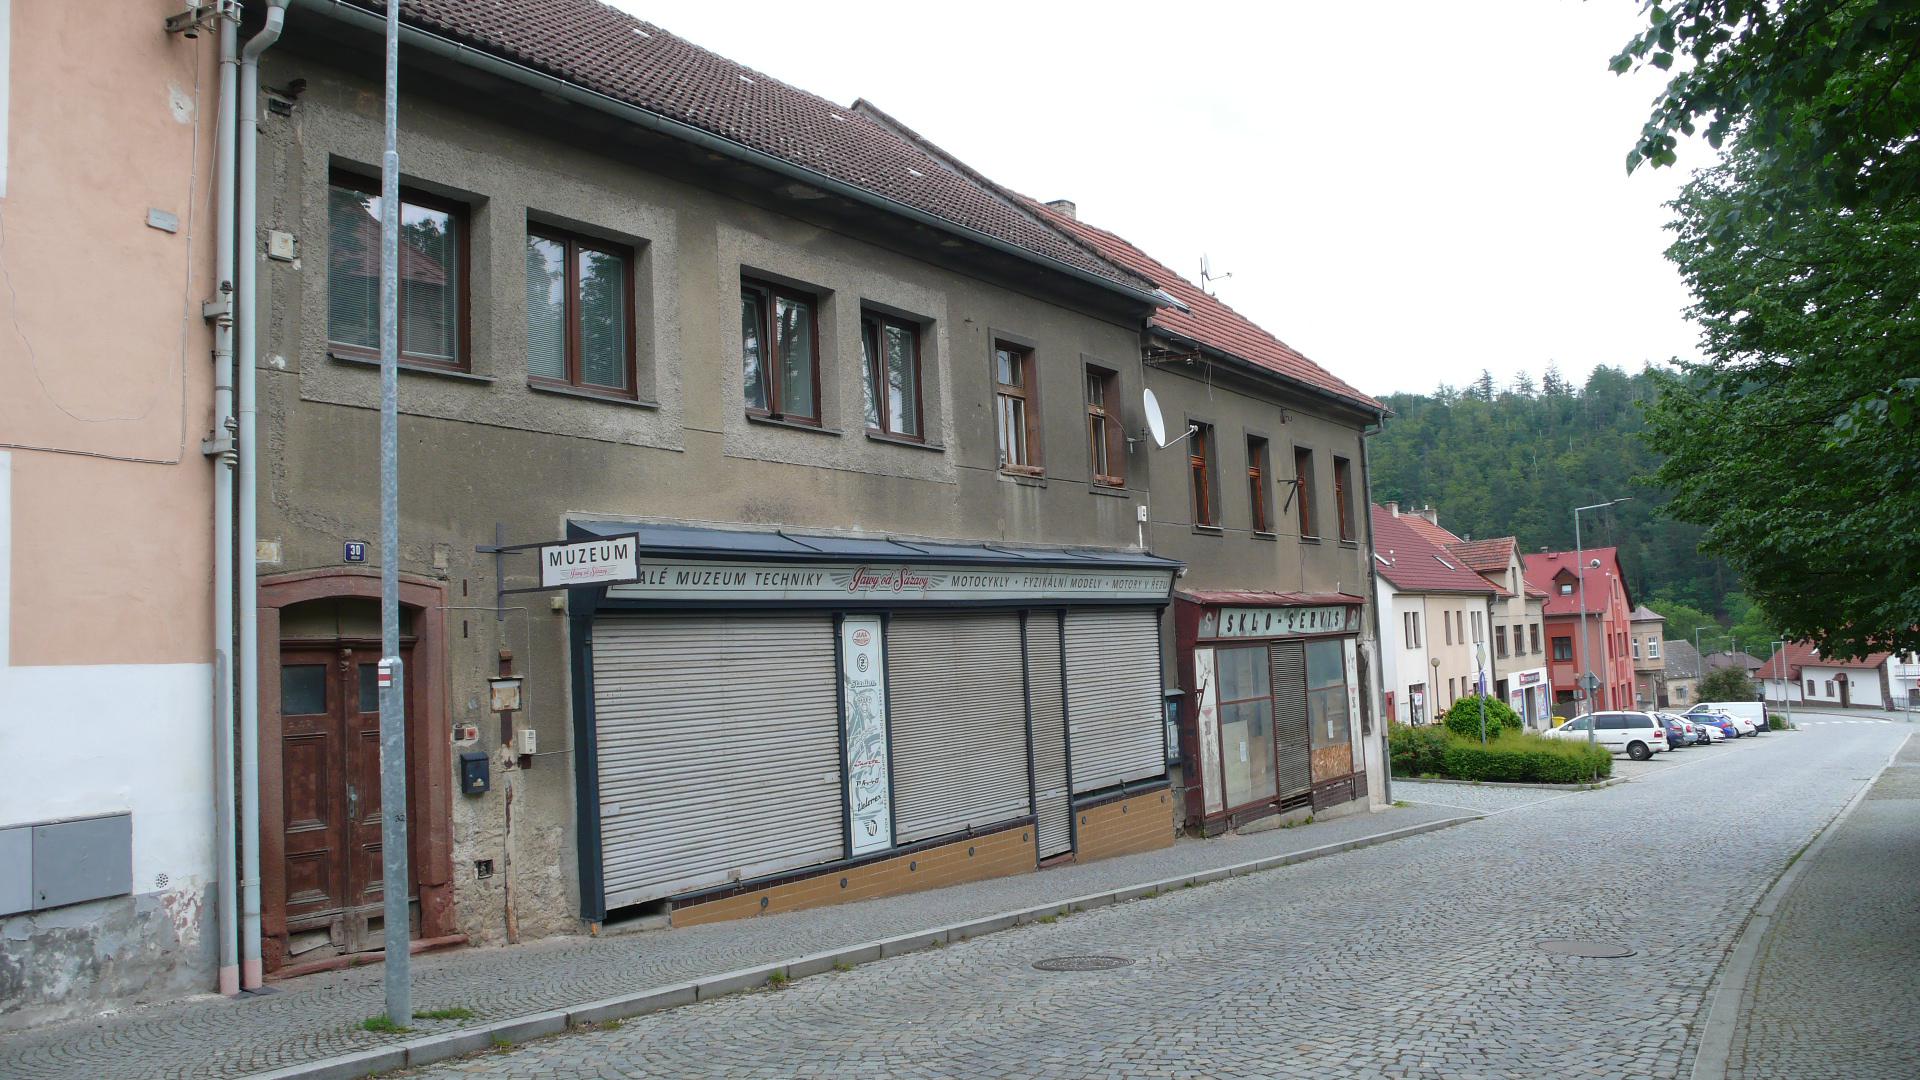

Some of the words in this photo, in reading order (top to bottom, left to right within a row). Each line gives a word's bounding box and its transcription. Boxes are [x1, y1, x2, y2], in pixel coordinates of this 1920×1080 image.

[350, 544, 361, 556] 30
[550, 544, 628, 567] MUZEUM
[640, 567, 668, 585] ALÉ
[676, 571, 747, 585] MUZEUM
[754, 572, 823, 587] TECHNIKY
[849, 566, 879, 591] Jawy
[880, 571, 894, 585] od
[894, 567, 929, 591] Sázavy
[951, 575, 1010, 588] MOTOCYKLY
[1023, 574, 1068, 588] FYZIKÁLNÍ
[1070, 577, 1102, 589] MODELY
[1111, 578, 1143, 590] MOTORY
[1144, 579, 1150, 590] V
